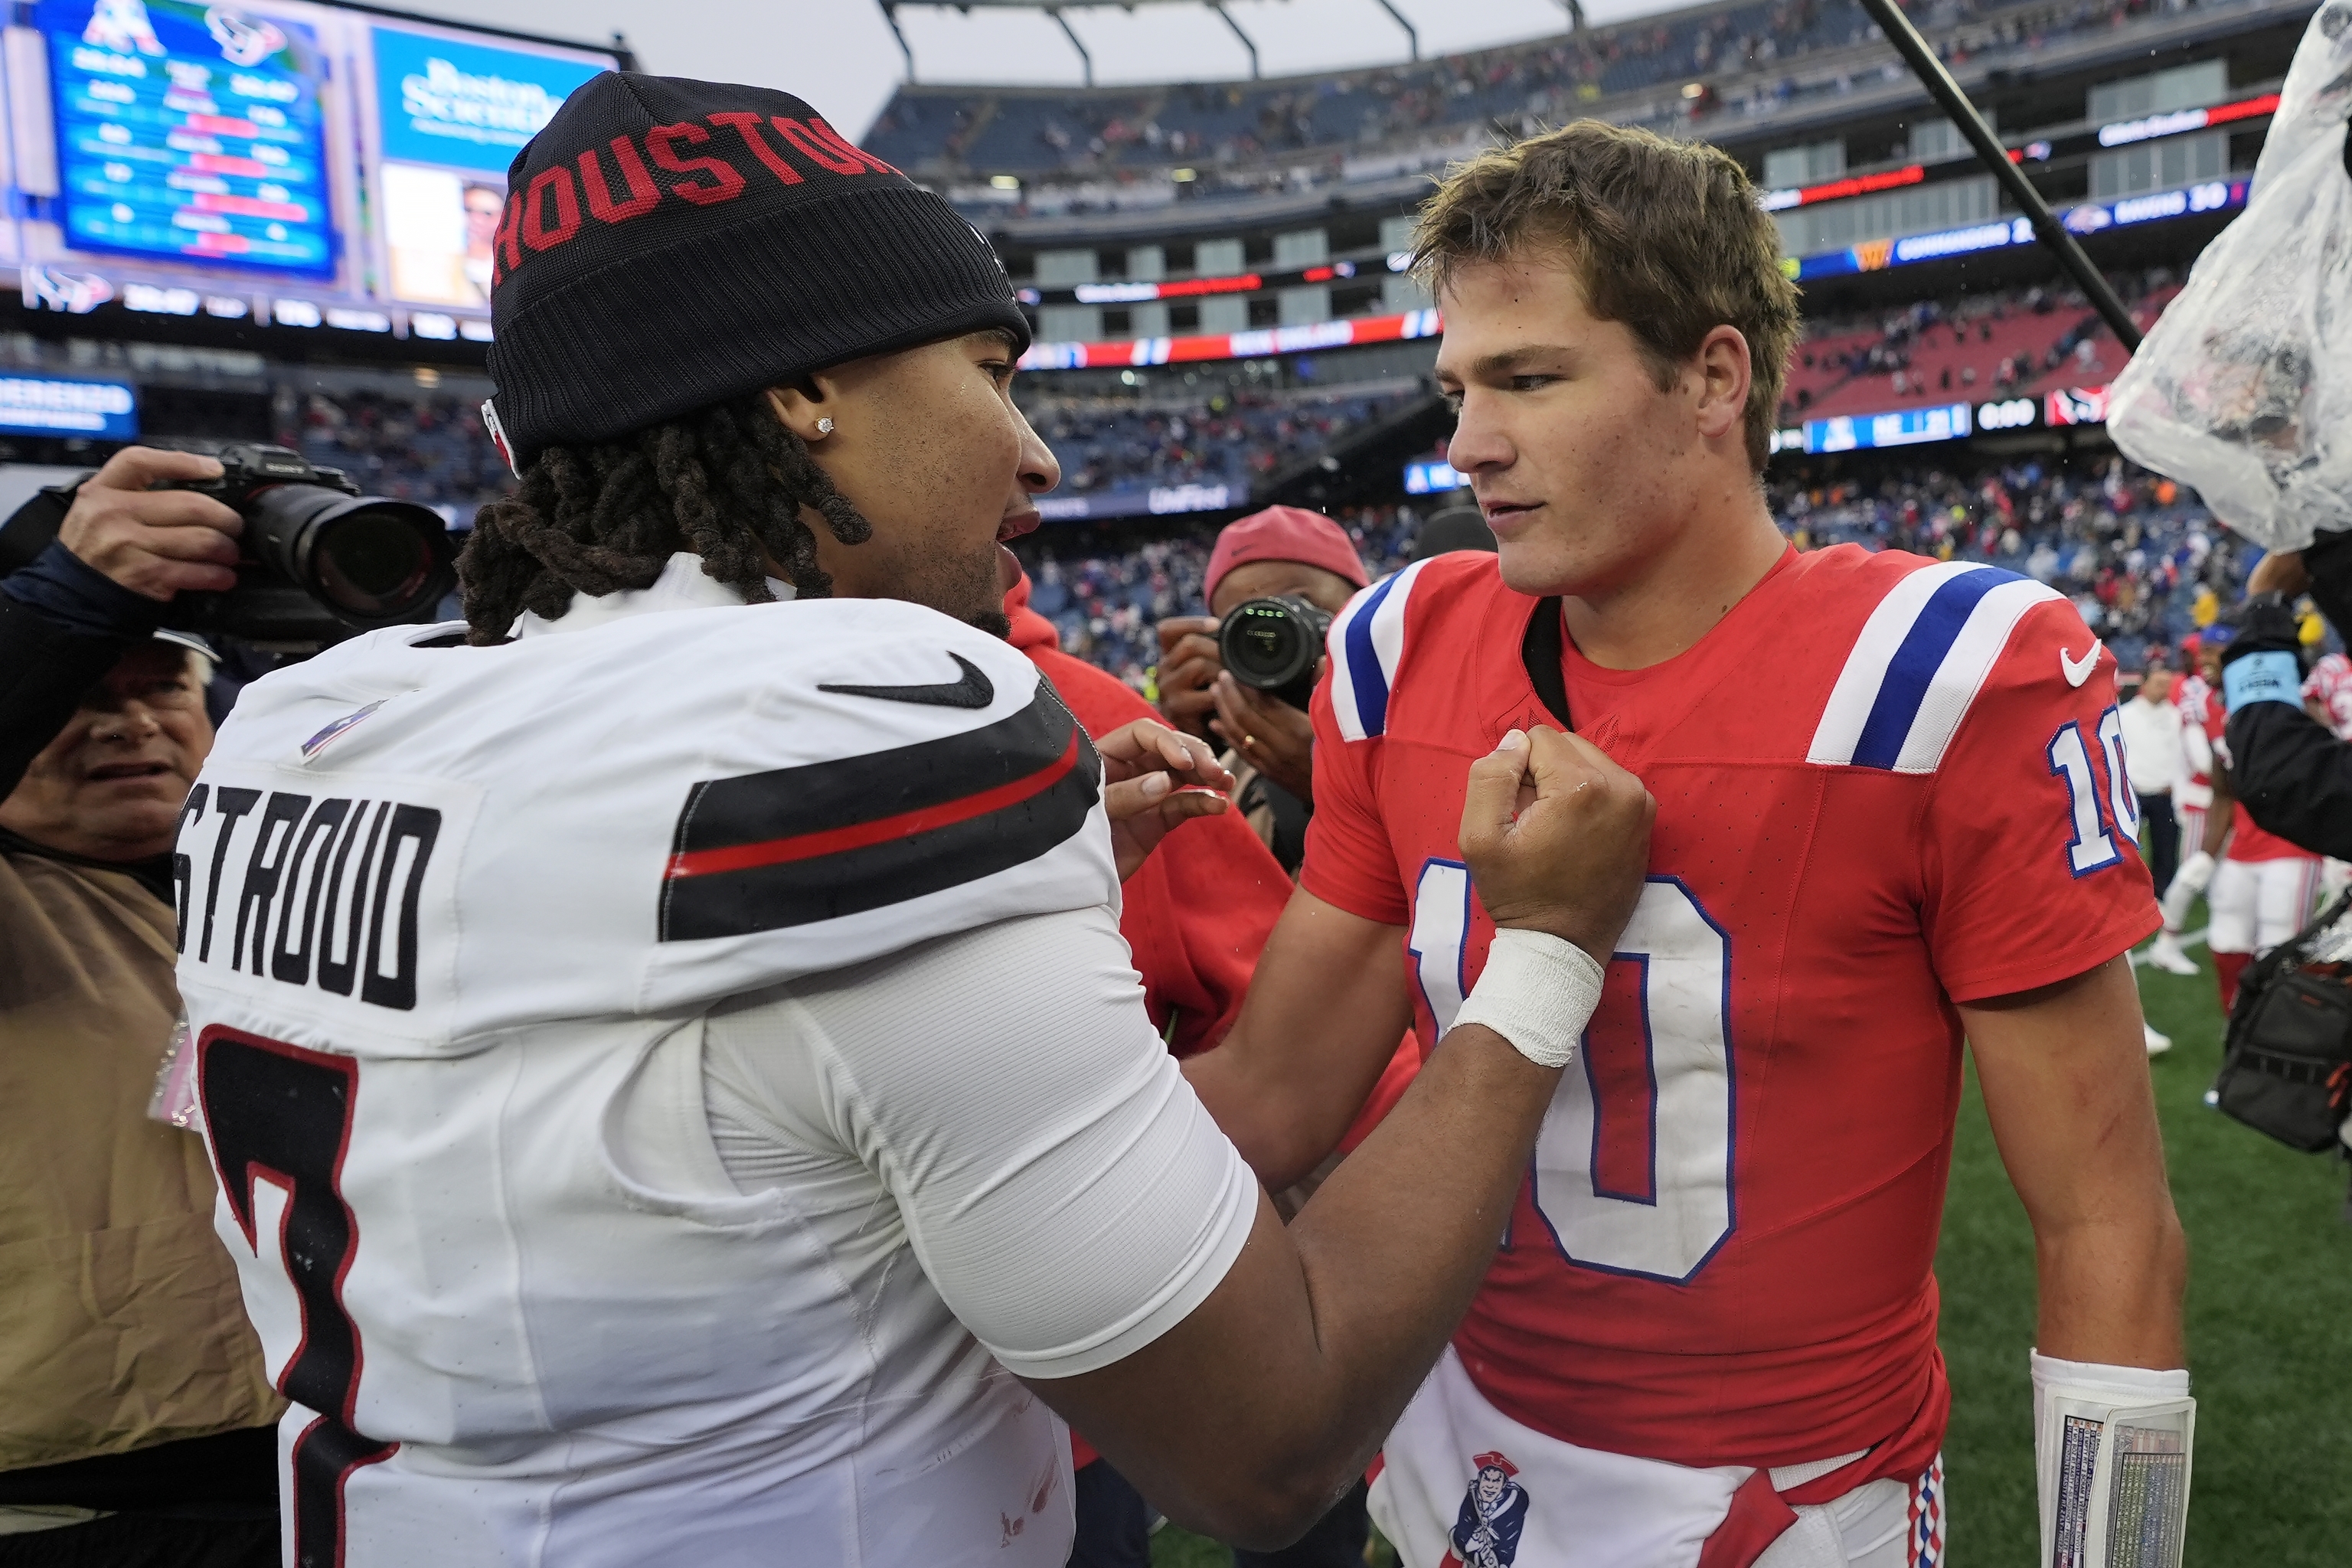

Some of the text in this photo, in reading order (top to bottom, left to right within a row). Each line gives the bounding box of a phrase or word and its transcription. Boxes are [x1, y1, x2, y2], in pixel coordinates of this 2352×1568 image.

[493, 112, 905, 286] HOUSTON
[2045, 704, 2141, 879] 10
[173, 782, 442, 1011] STROUD
[198, 1023, 400, 1567] 7
